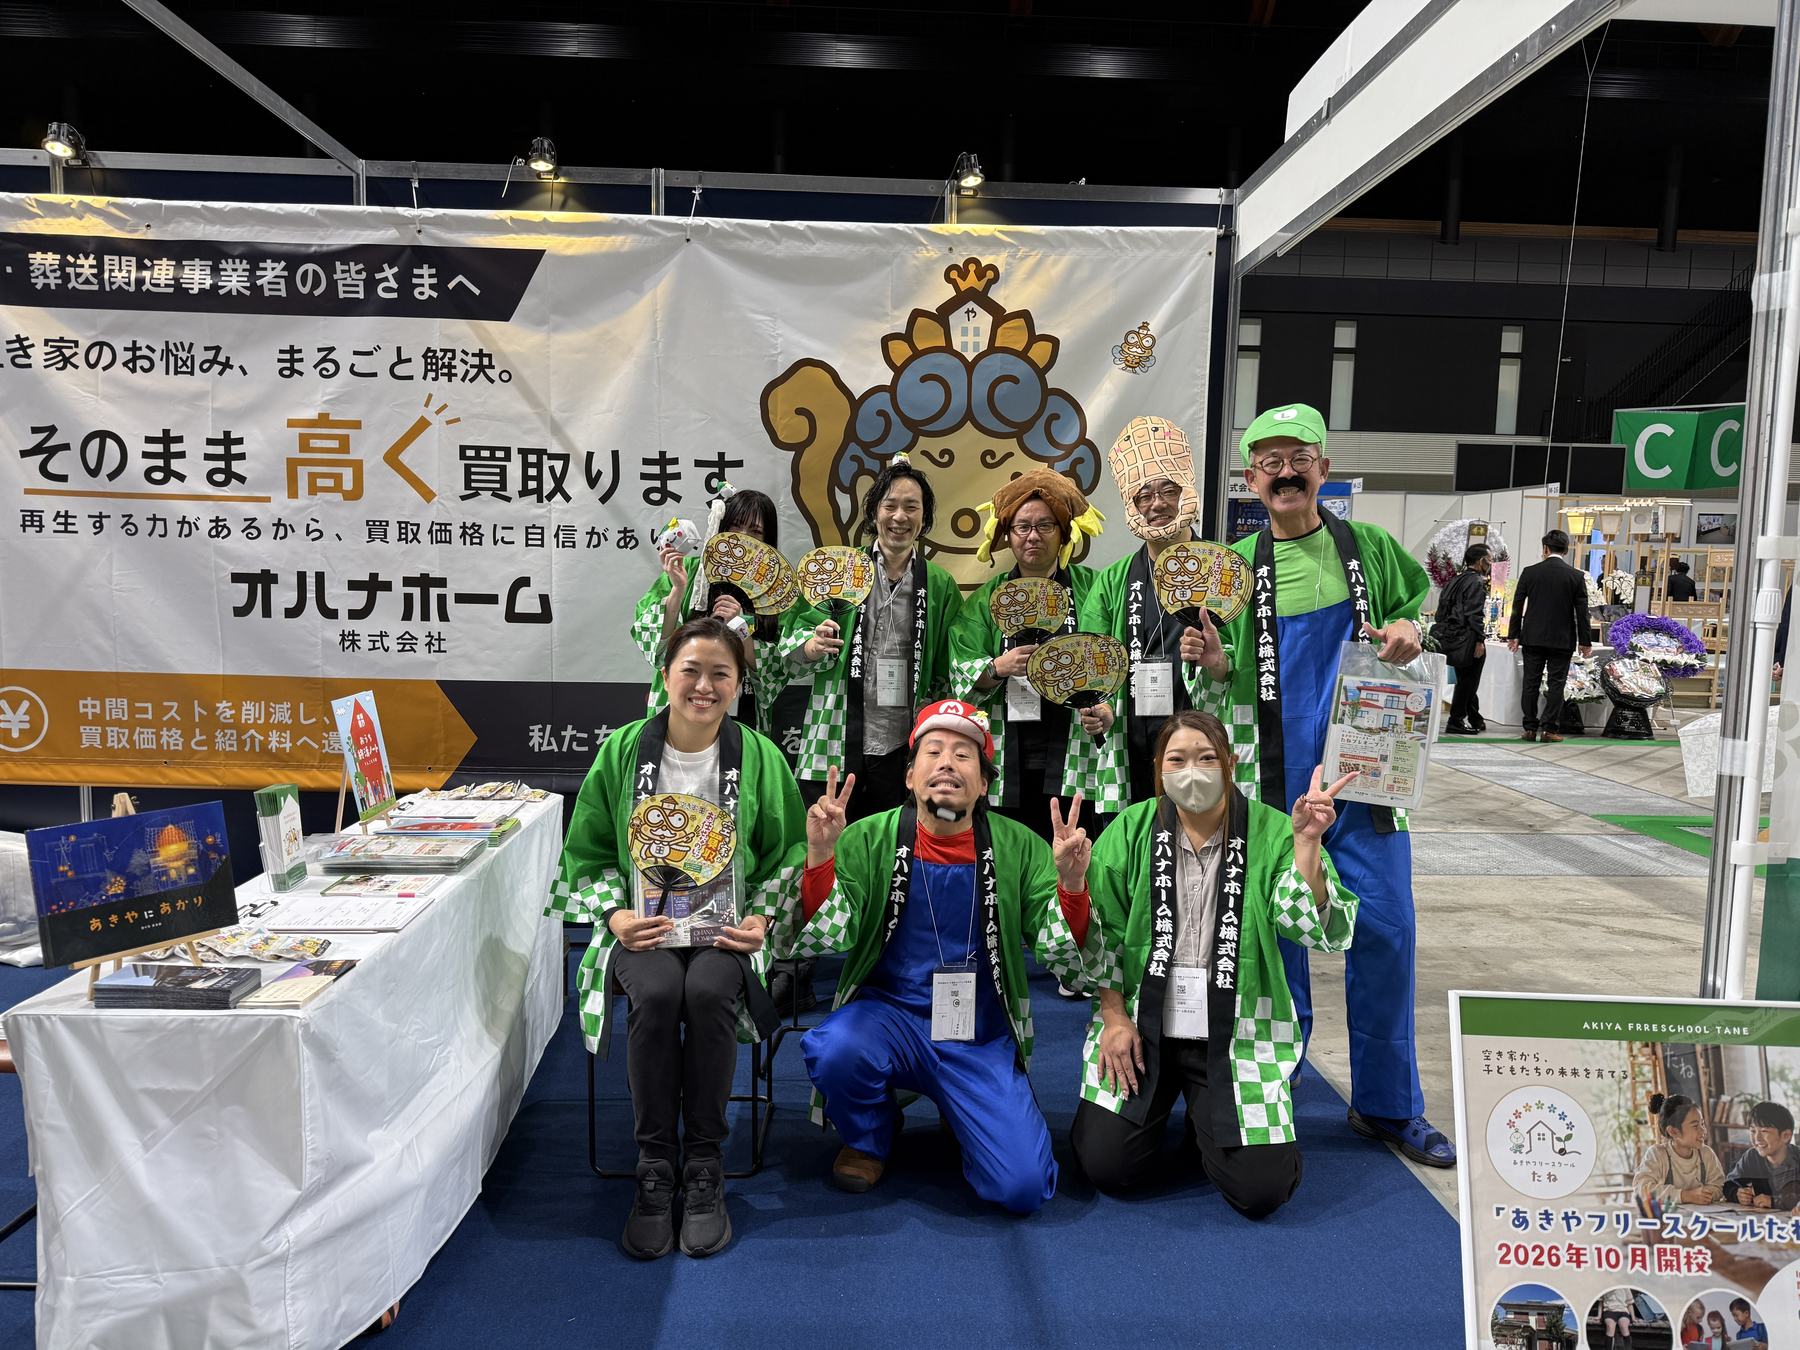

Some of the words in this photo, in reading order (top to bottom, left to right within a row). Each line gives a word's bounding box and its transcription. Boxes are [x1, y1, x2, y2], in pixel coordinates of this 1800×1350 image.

[965, 307, 977, 322] や
[0, 333, 513, 384] き家のお悩み、まるごと解決。
[19, 424, 248, 487] そのまま
[286, 412, 437, 503] 高く
[458, 444, 744, 508] 買取ります
[1634, 423, 1675, 479] C
[1711, 420, 1740, 477] C
[1229, 484, 1253, 493] 式会
[231, 570, 553, 624] オハナホーム
[338, 629, 448, 654] 株式会社
[1255, 565, 1277, 701] オハナホーム株式会社
[79, 697, 331, 727] 中間コストを削減し、
[943, 704, 960, 714] M
[1148, 830, 1173, 978] オハナホーム株式会社
[1215, 836, 1246, 990] オハナホーム株式会社
[1583, 1022, 1622, 1031] AKIYA
[1628, 1023, 1710, 1035] FRRESCHOOL
[1716, 1026, 1750, 1035] TANE
[1483, 1064, 1629, 1080] 子どもたちの未来を育てる
[1532, 1171, 1558, 1183] たね
[1499, 1242, 1712, 1274] 2026年10月開校
